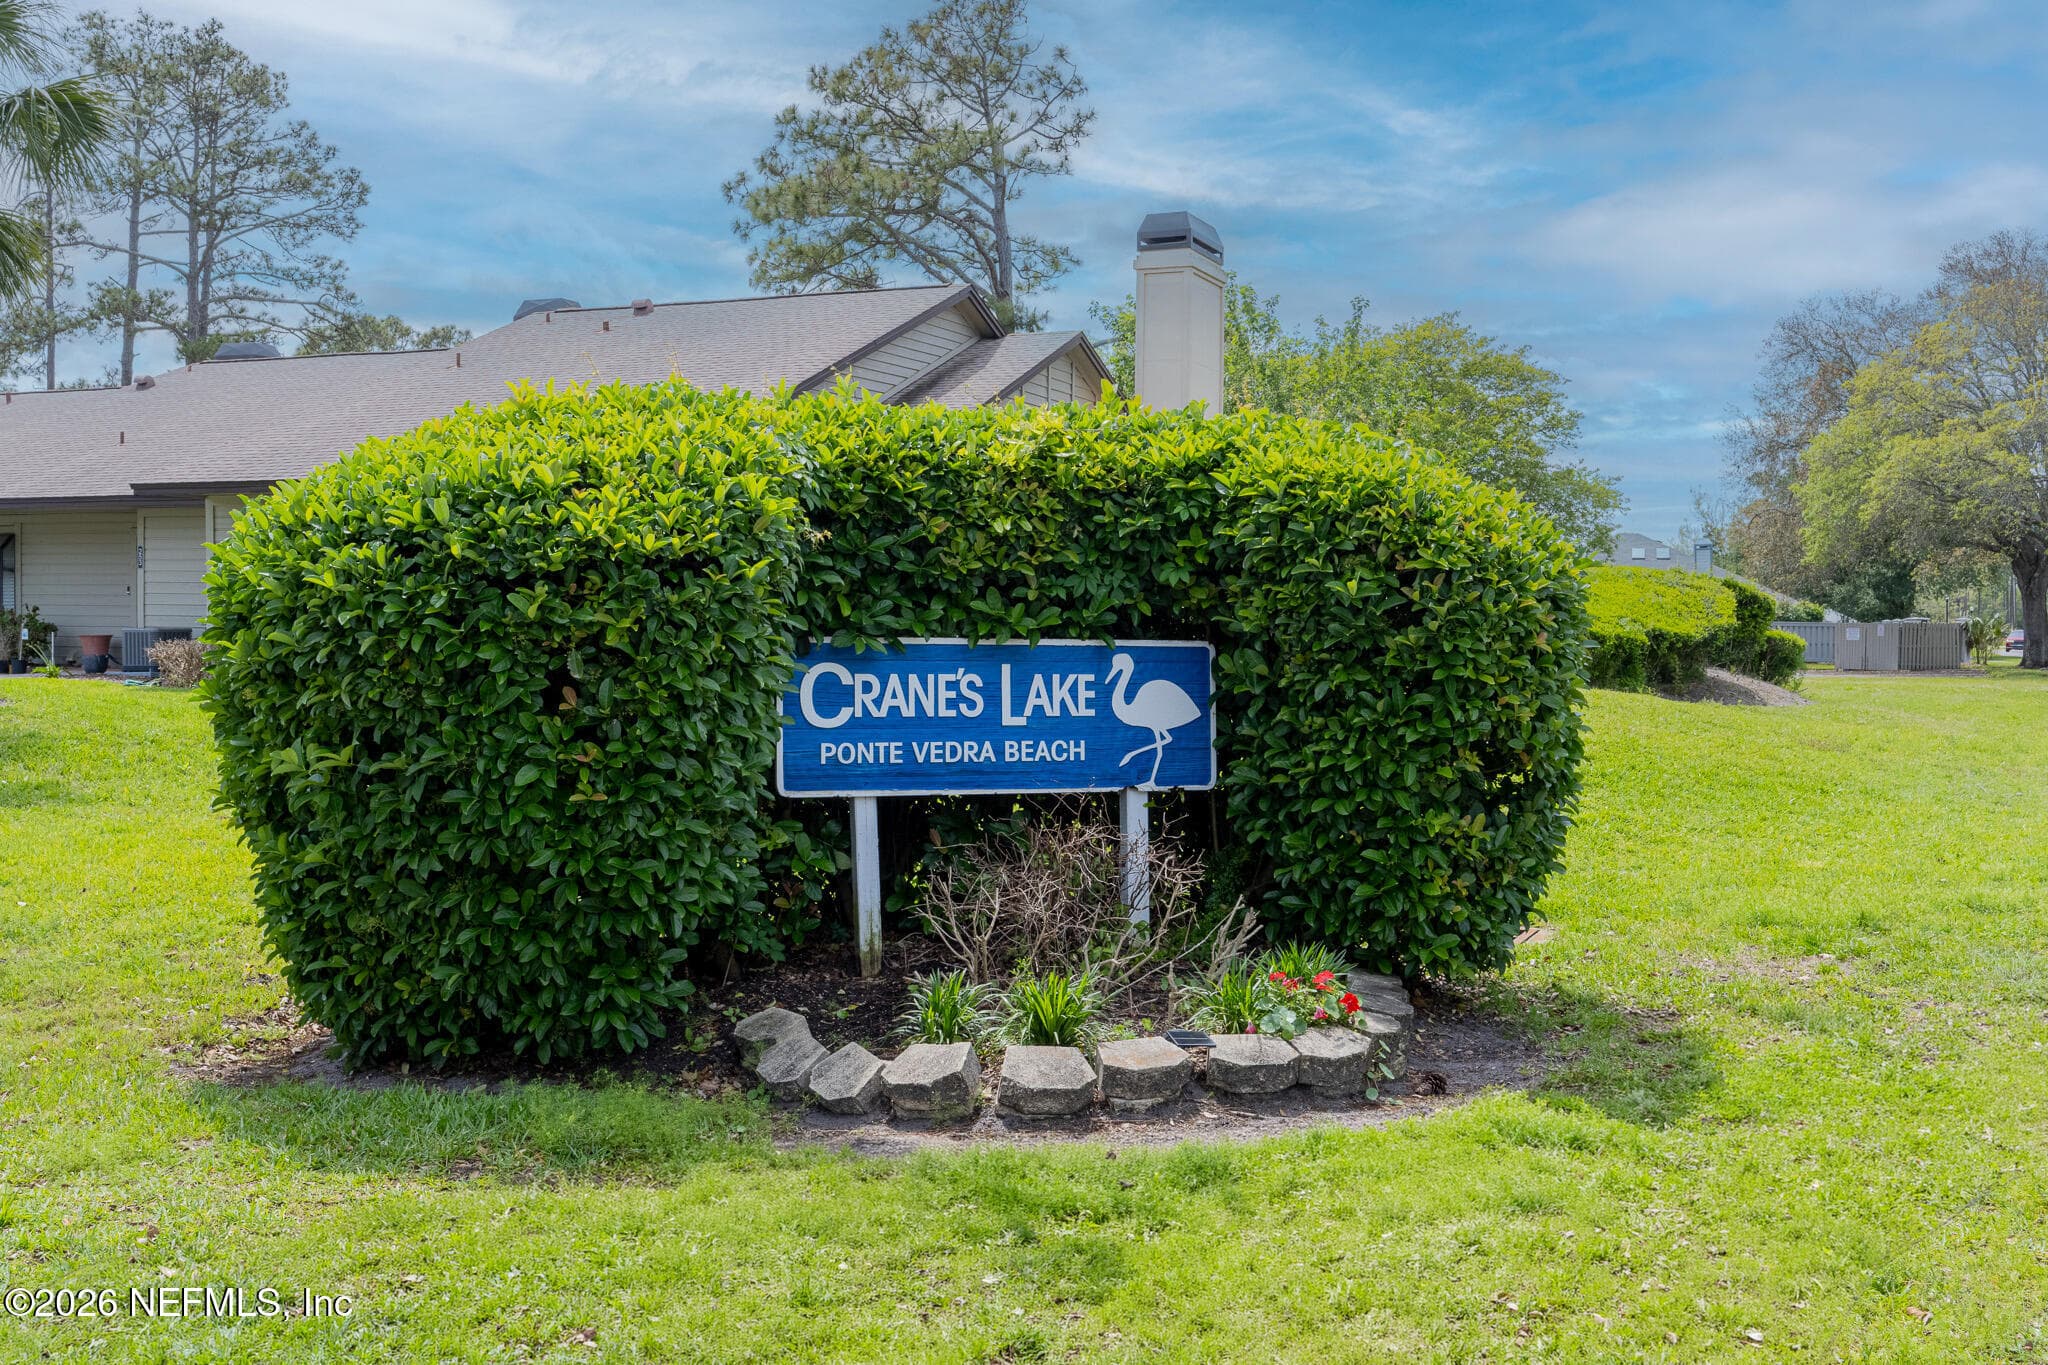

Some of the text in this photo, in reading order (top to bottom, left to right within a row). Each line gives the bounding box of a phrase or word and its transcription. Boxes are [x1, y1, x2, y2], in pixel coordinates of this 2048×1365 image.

[801, 662, 1095, 728] CRANE'S LAKE
[820, 740, 1085, 765] PONTE VEDRA BEACH
